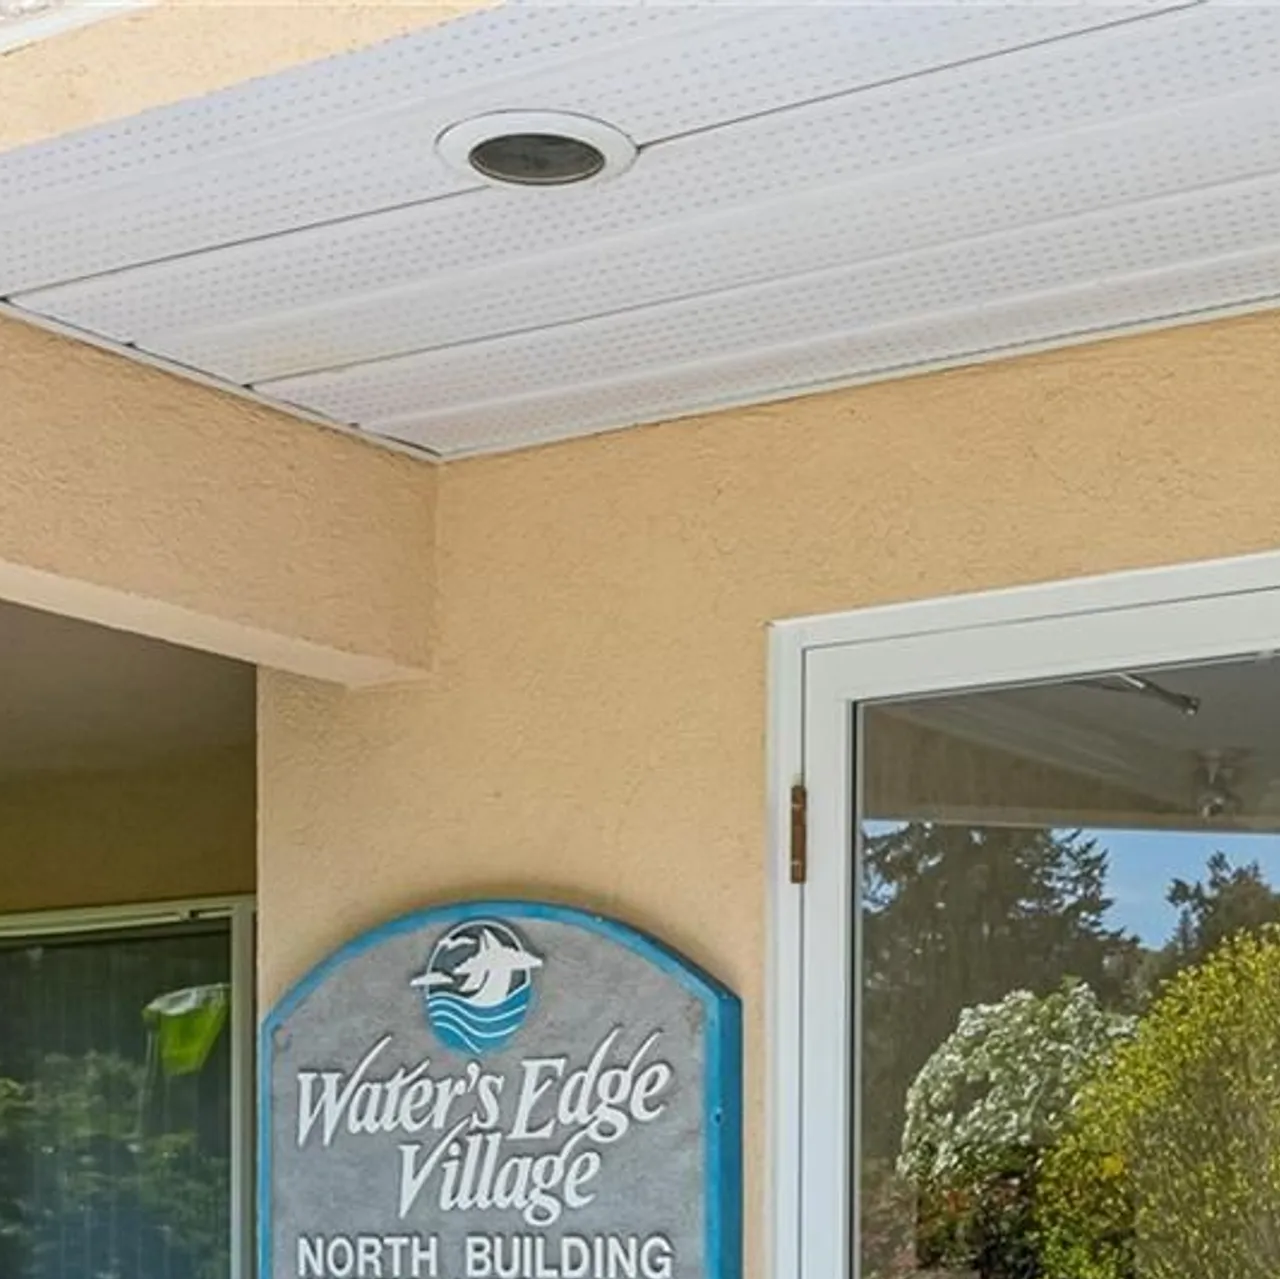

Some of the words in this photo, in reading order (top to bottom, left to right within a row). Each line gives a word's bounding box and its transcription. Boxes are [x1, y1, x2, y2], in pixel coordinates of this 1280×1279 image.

[295, 1034, 506, 1149] Water's
[505, 1024, 672, 1144] Edge
[399, 1116, 602, 1227] Village
[297, 1237, 438, 1278] NORTH
[465, 1236, 673, 1279] BUILDING
